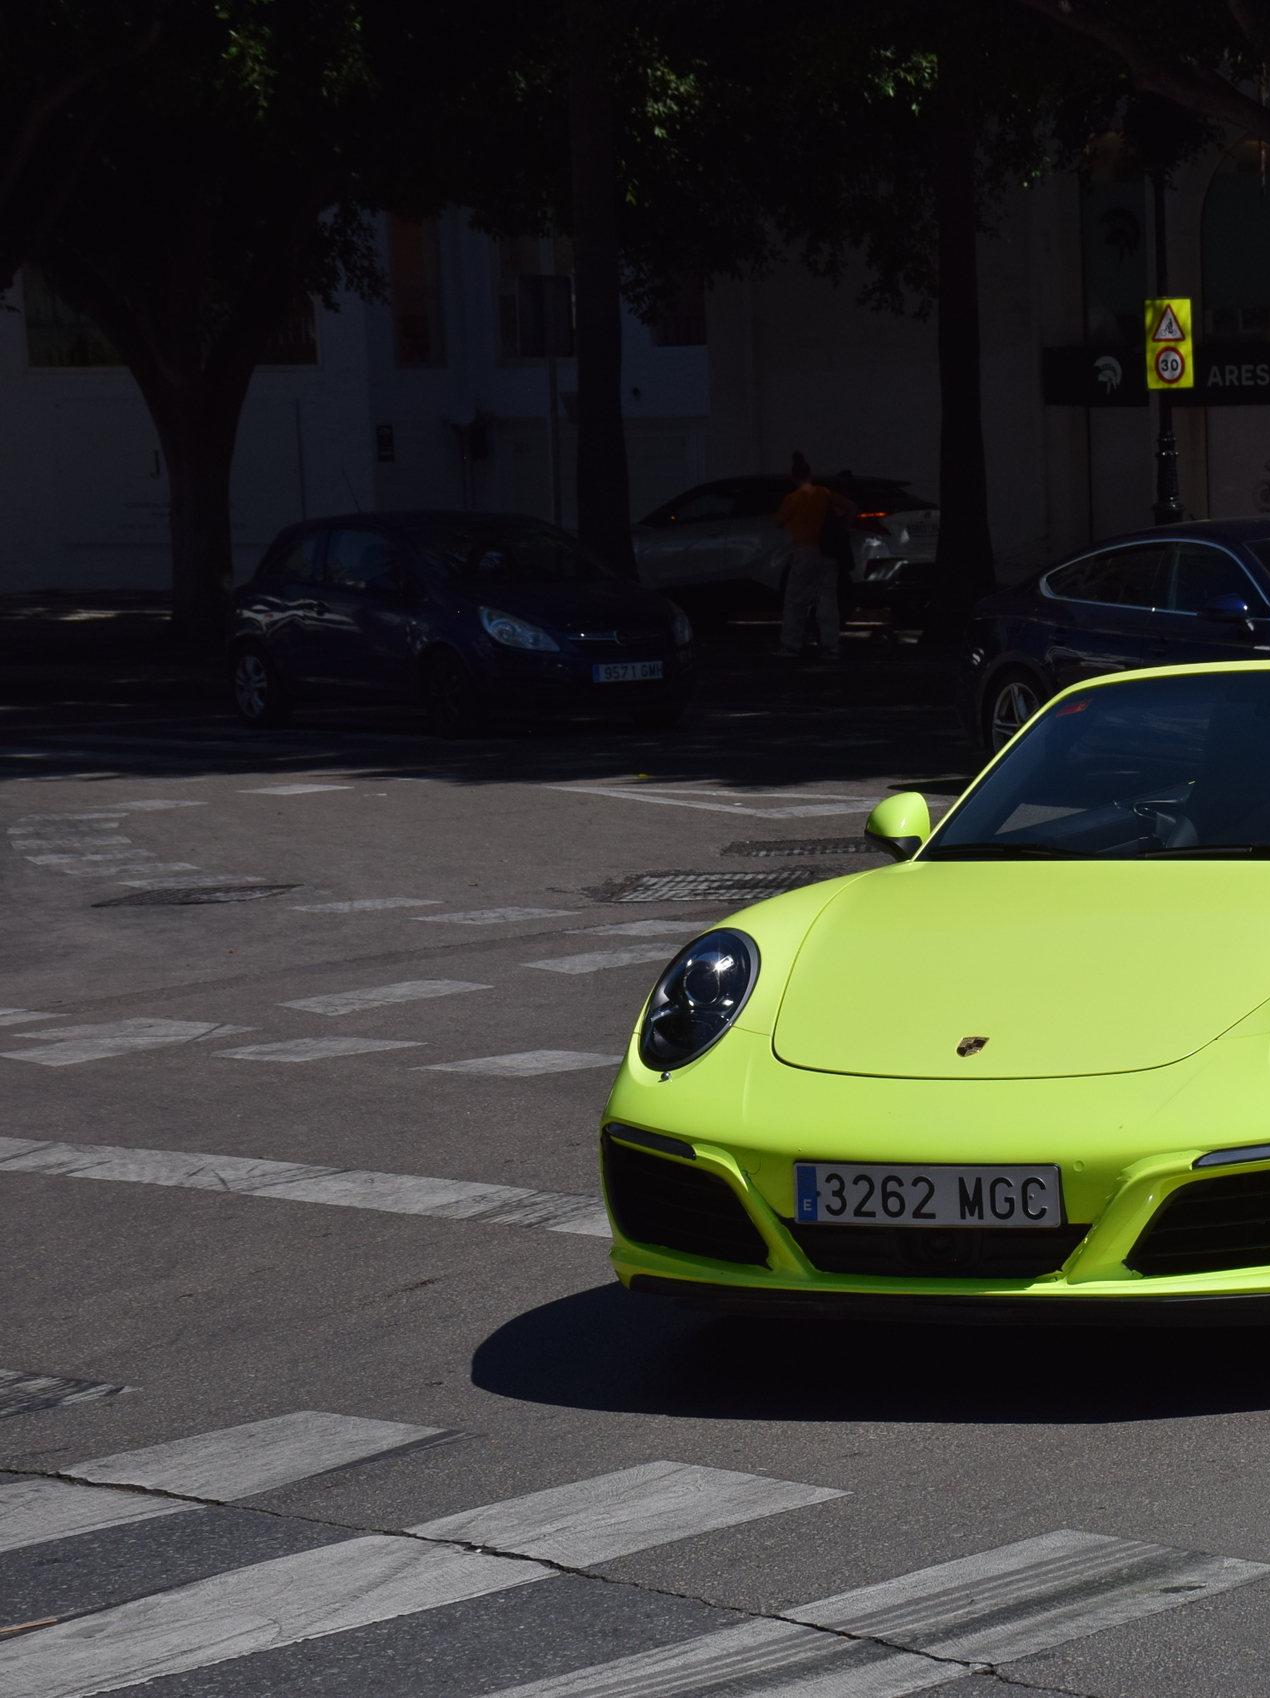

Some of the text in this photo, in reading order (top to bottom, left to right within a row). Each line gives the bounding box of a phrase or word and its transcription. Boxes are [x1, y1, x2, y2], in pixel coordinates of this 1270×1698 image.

[1161, 359, 1179, 371] 30
[604, 665, 636, 680] 9571
[824, 1173, 1048, 1220] 3262 MGC
[803, 1199, 812, 1211] E
